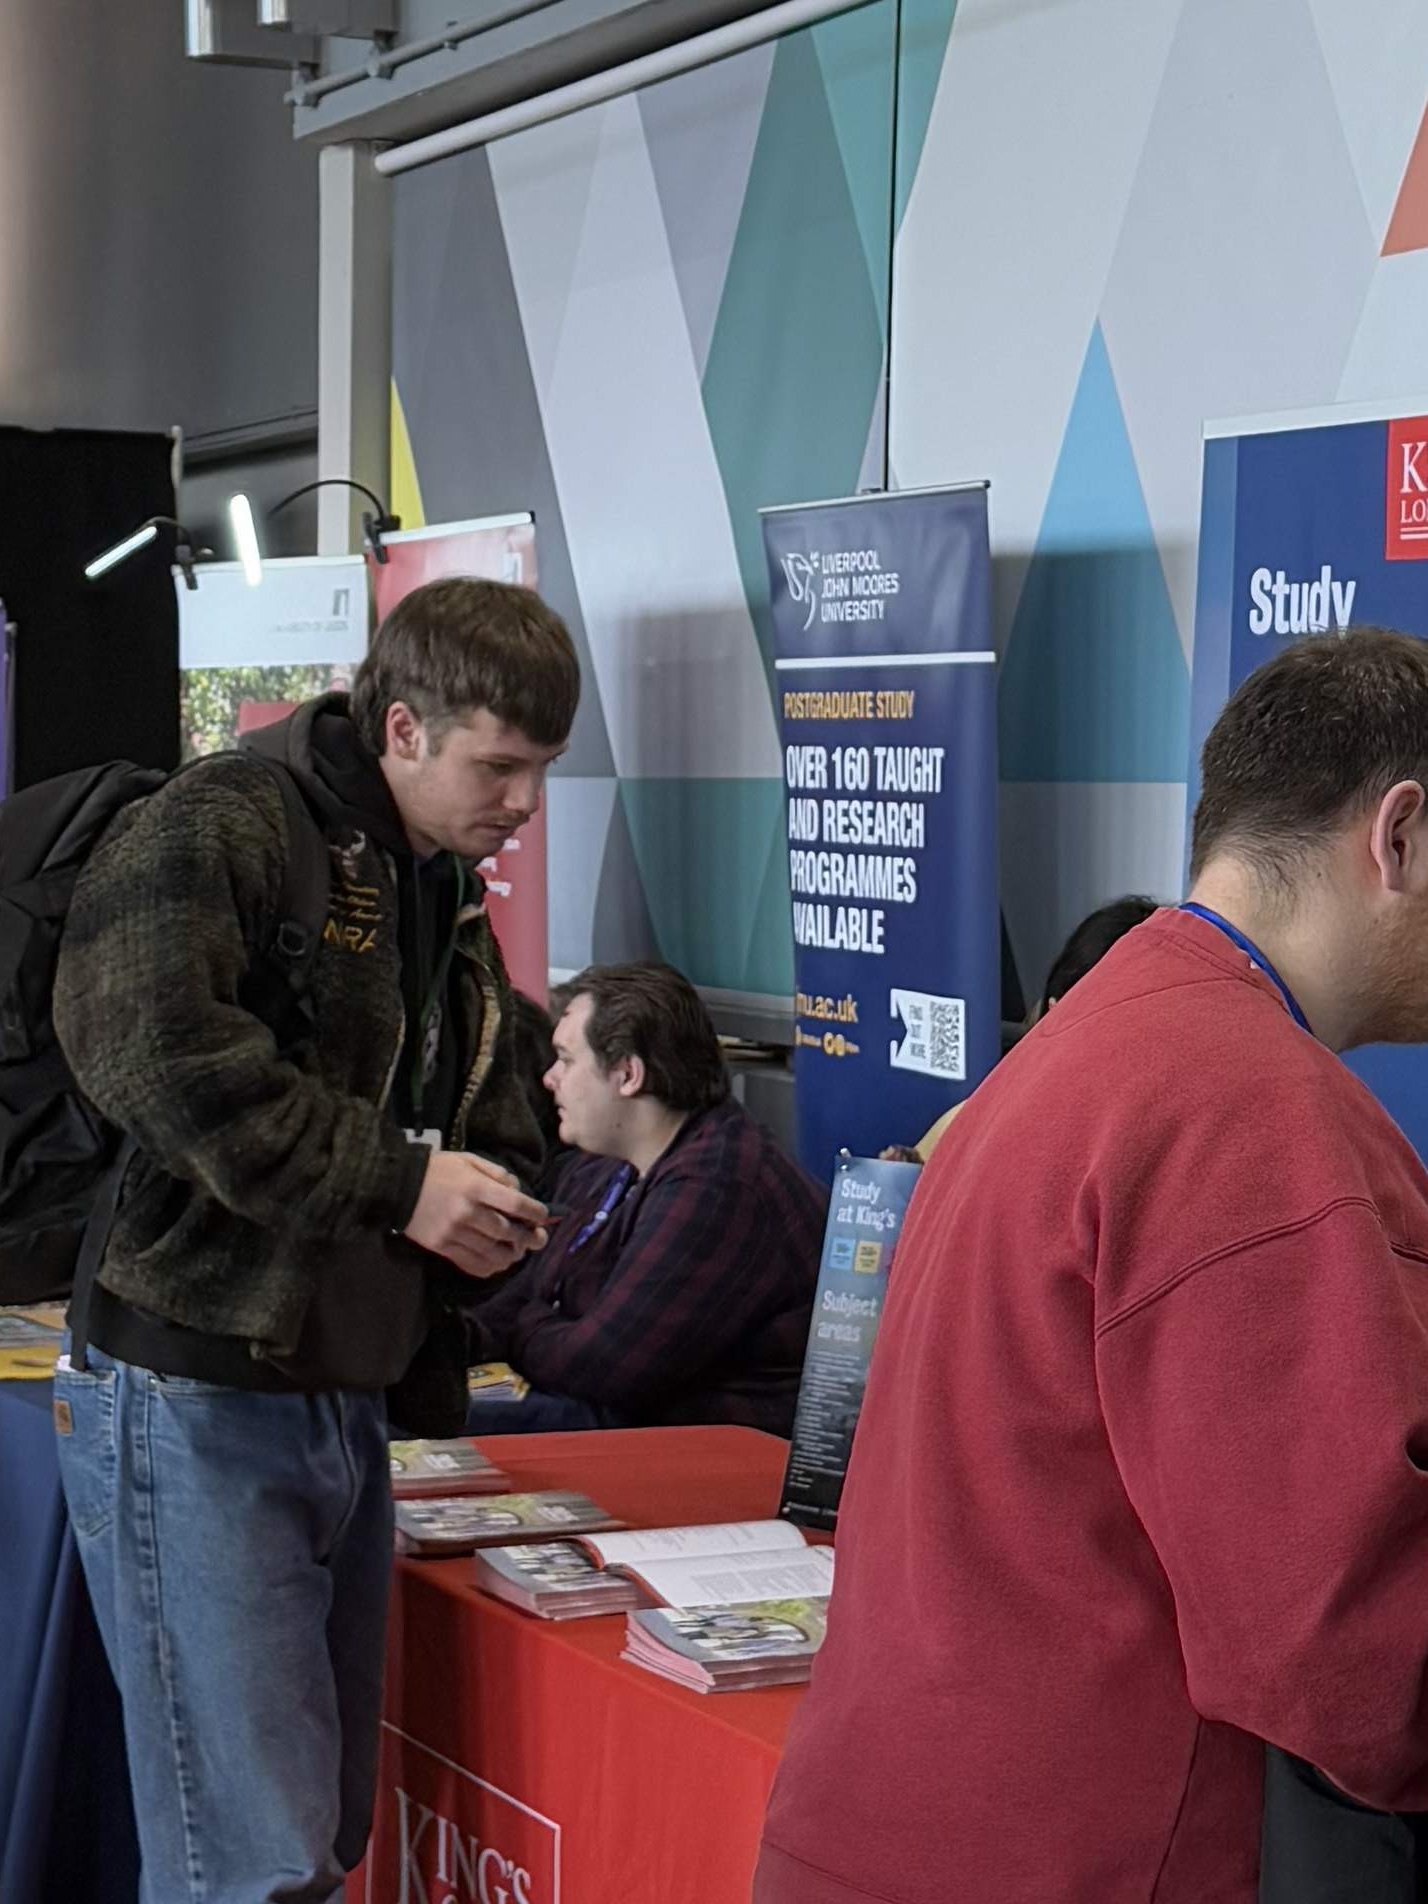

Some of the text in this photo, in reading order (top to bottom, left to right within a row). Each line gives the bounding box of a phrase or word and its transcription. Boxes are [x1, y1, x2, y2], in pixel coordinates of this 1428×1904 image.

[821, 550, 881, 575] LIVERPOOL
[821, 573, 900, 598] JOHN MOORES
[821, 599, 884, 622] UNIVERSITY
[784, 690, 914, 719] POSTGRADUATE STUDY
[786, 745, 944, 793] OVER 160 TAUGHT
[788, 798, 925, 848] AND RESEARCH
[790, 849, 917, 904] PROGRAMMES
[842, 1178, 881, 1204] Study
[837, 1205, 896, 1232] at King's
[822, 1290, 878, 1317] Subject
[817, 1322, 861, 1342] areas
